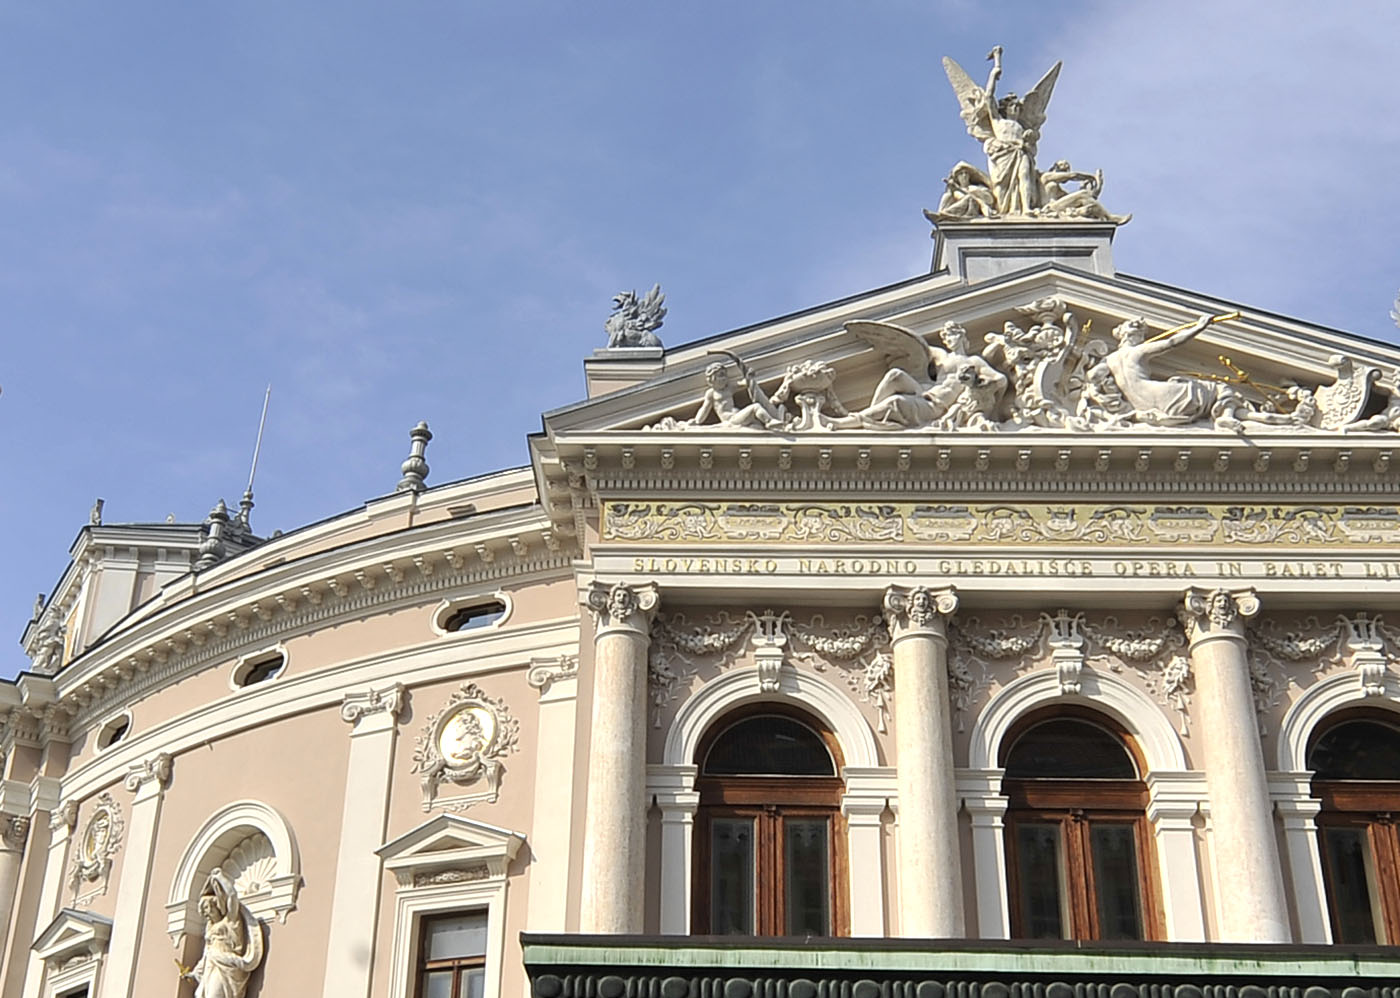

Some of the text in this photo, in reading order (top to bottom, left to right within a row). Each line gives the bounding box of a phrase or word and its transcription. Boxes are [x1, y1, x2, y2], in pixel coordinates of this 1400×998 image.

[633, 558, 778, 573] SLOVENSKO
[799, 559, 917, 574] NARODNO
[1113, 561, 1197, 576] OPERA
[1216, 562, 1243, 576] IN
[1264, 562, 1343, 577] BALET
